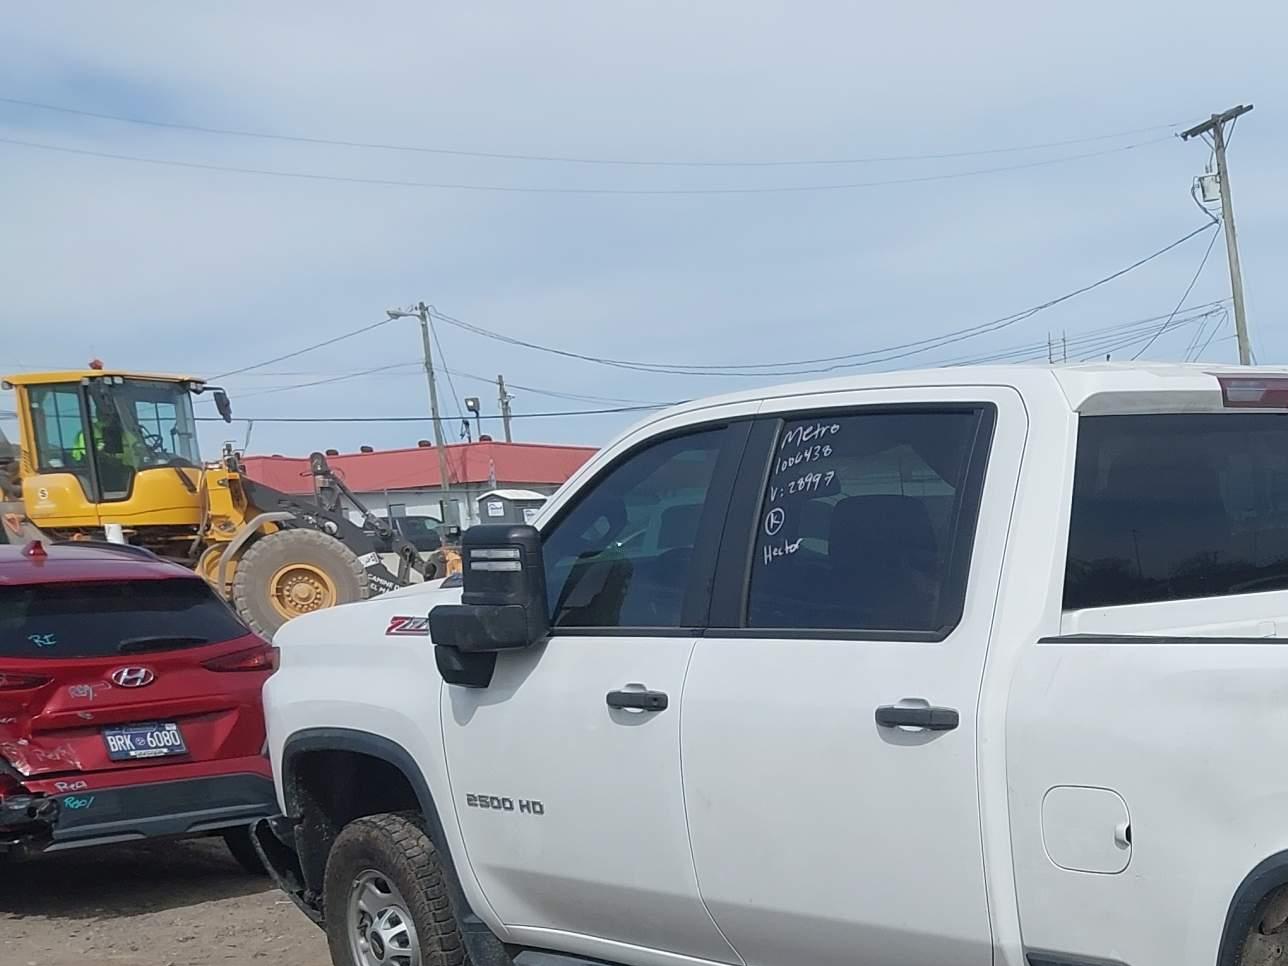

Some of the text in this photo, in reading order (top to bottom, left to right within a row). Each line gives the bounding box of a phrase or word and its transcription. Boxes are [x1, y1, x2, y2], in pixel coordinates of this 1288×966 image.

[782, 422, 840, 449] Metro
[106, 730, 181, 752] BRK 6080
[466, 793, 545, 815] 2500 HD
